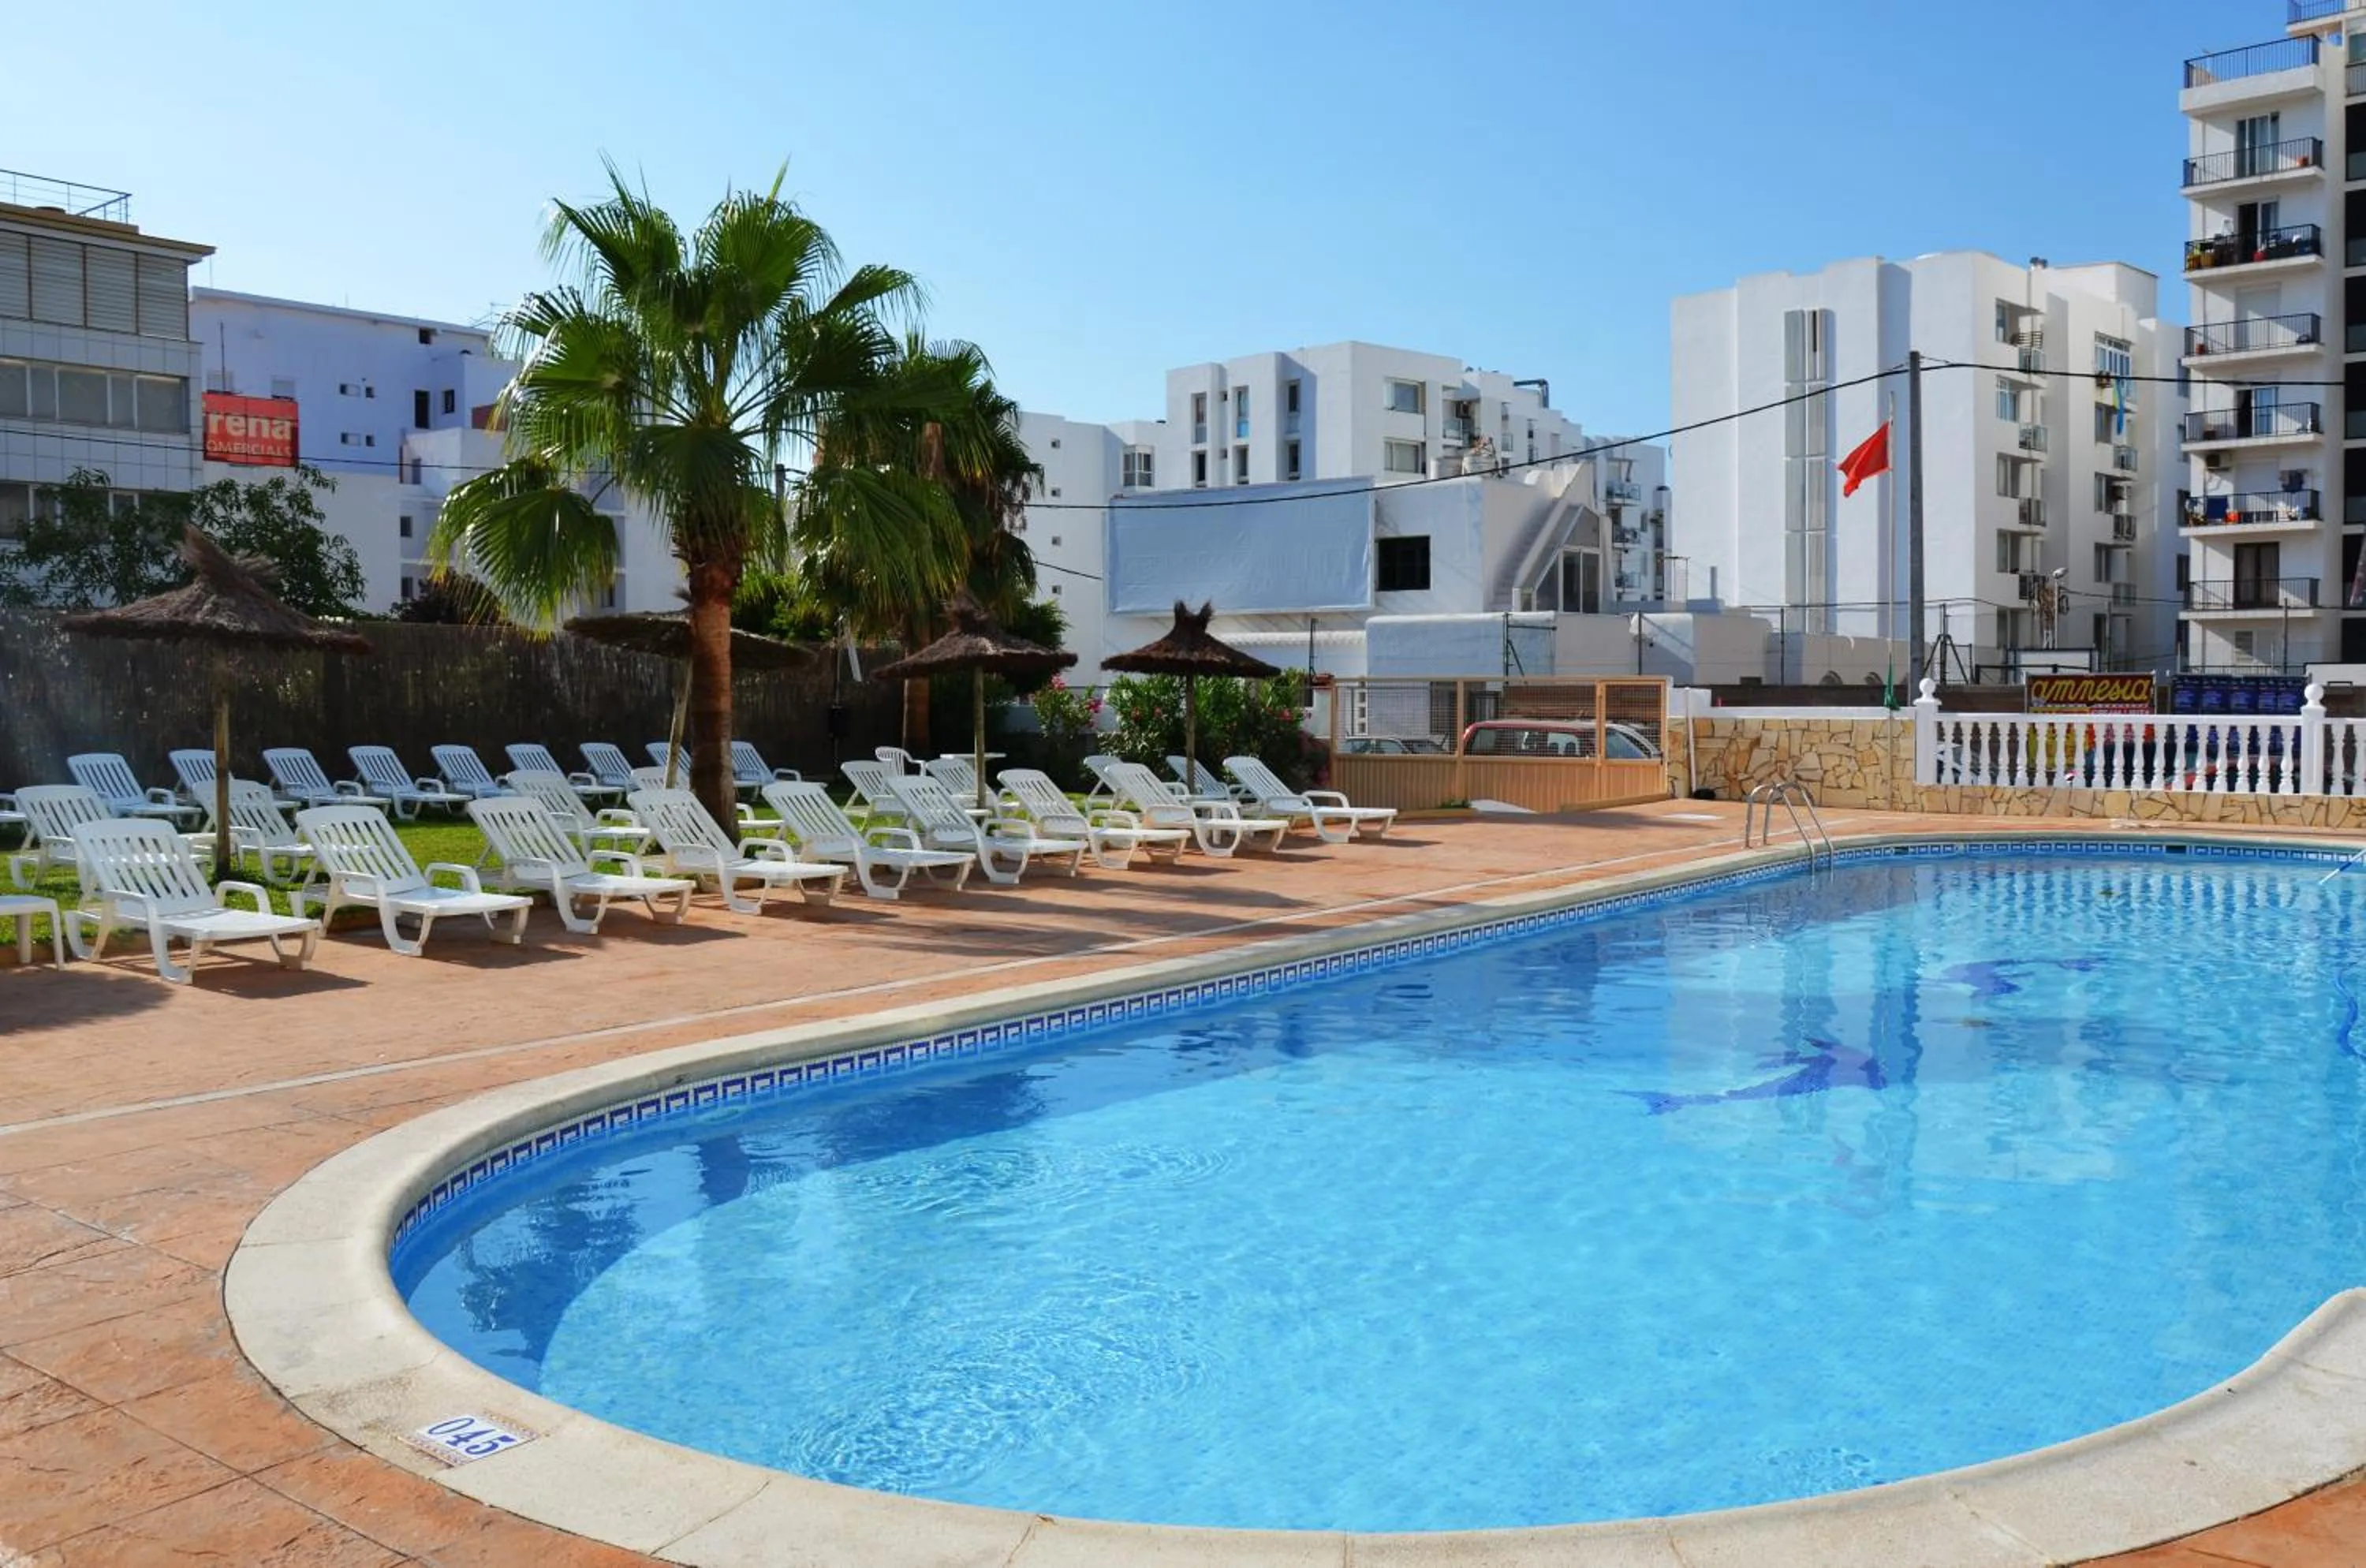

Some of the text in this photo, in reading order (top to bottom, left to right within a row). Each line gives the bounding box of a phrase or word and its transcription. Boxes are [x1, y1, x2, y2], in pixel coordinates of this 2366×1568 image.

[207, 413, 291, 440] rena
[207, 439, 292, 457] OMERCIALS
[2031, 678, 2151, 702] amnesia
[427, 1417, 517, 1455] 045
